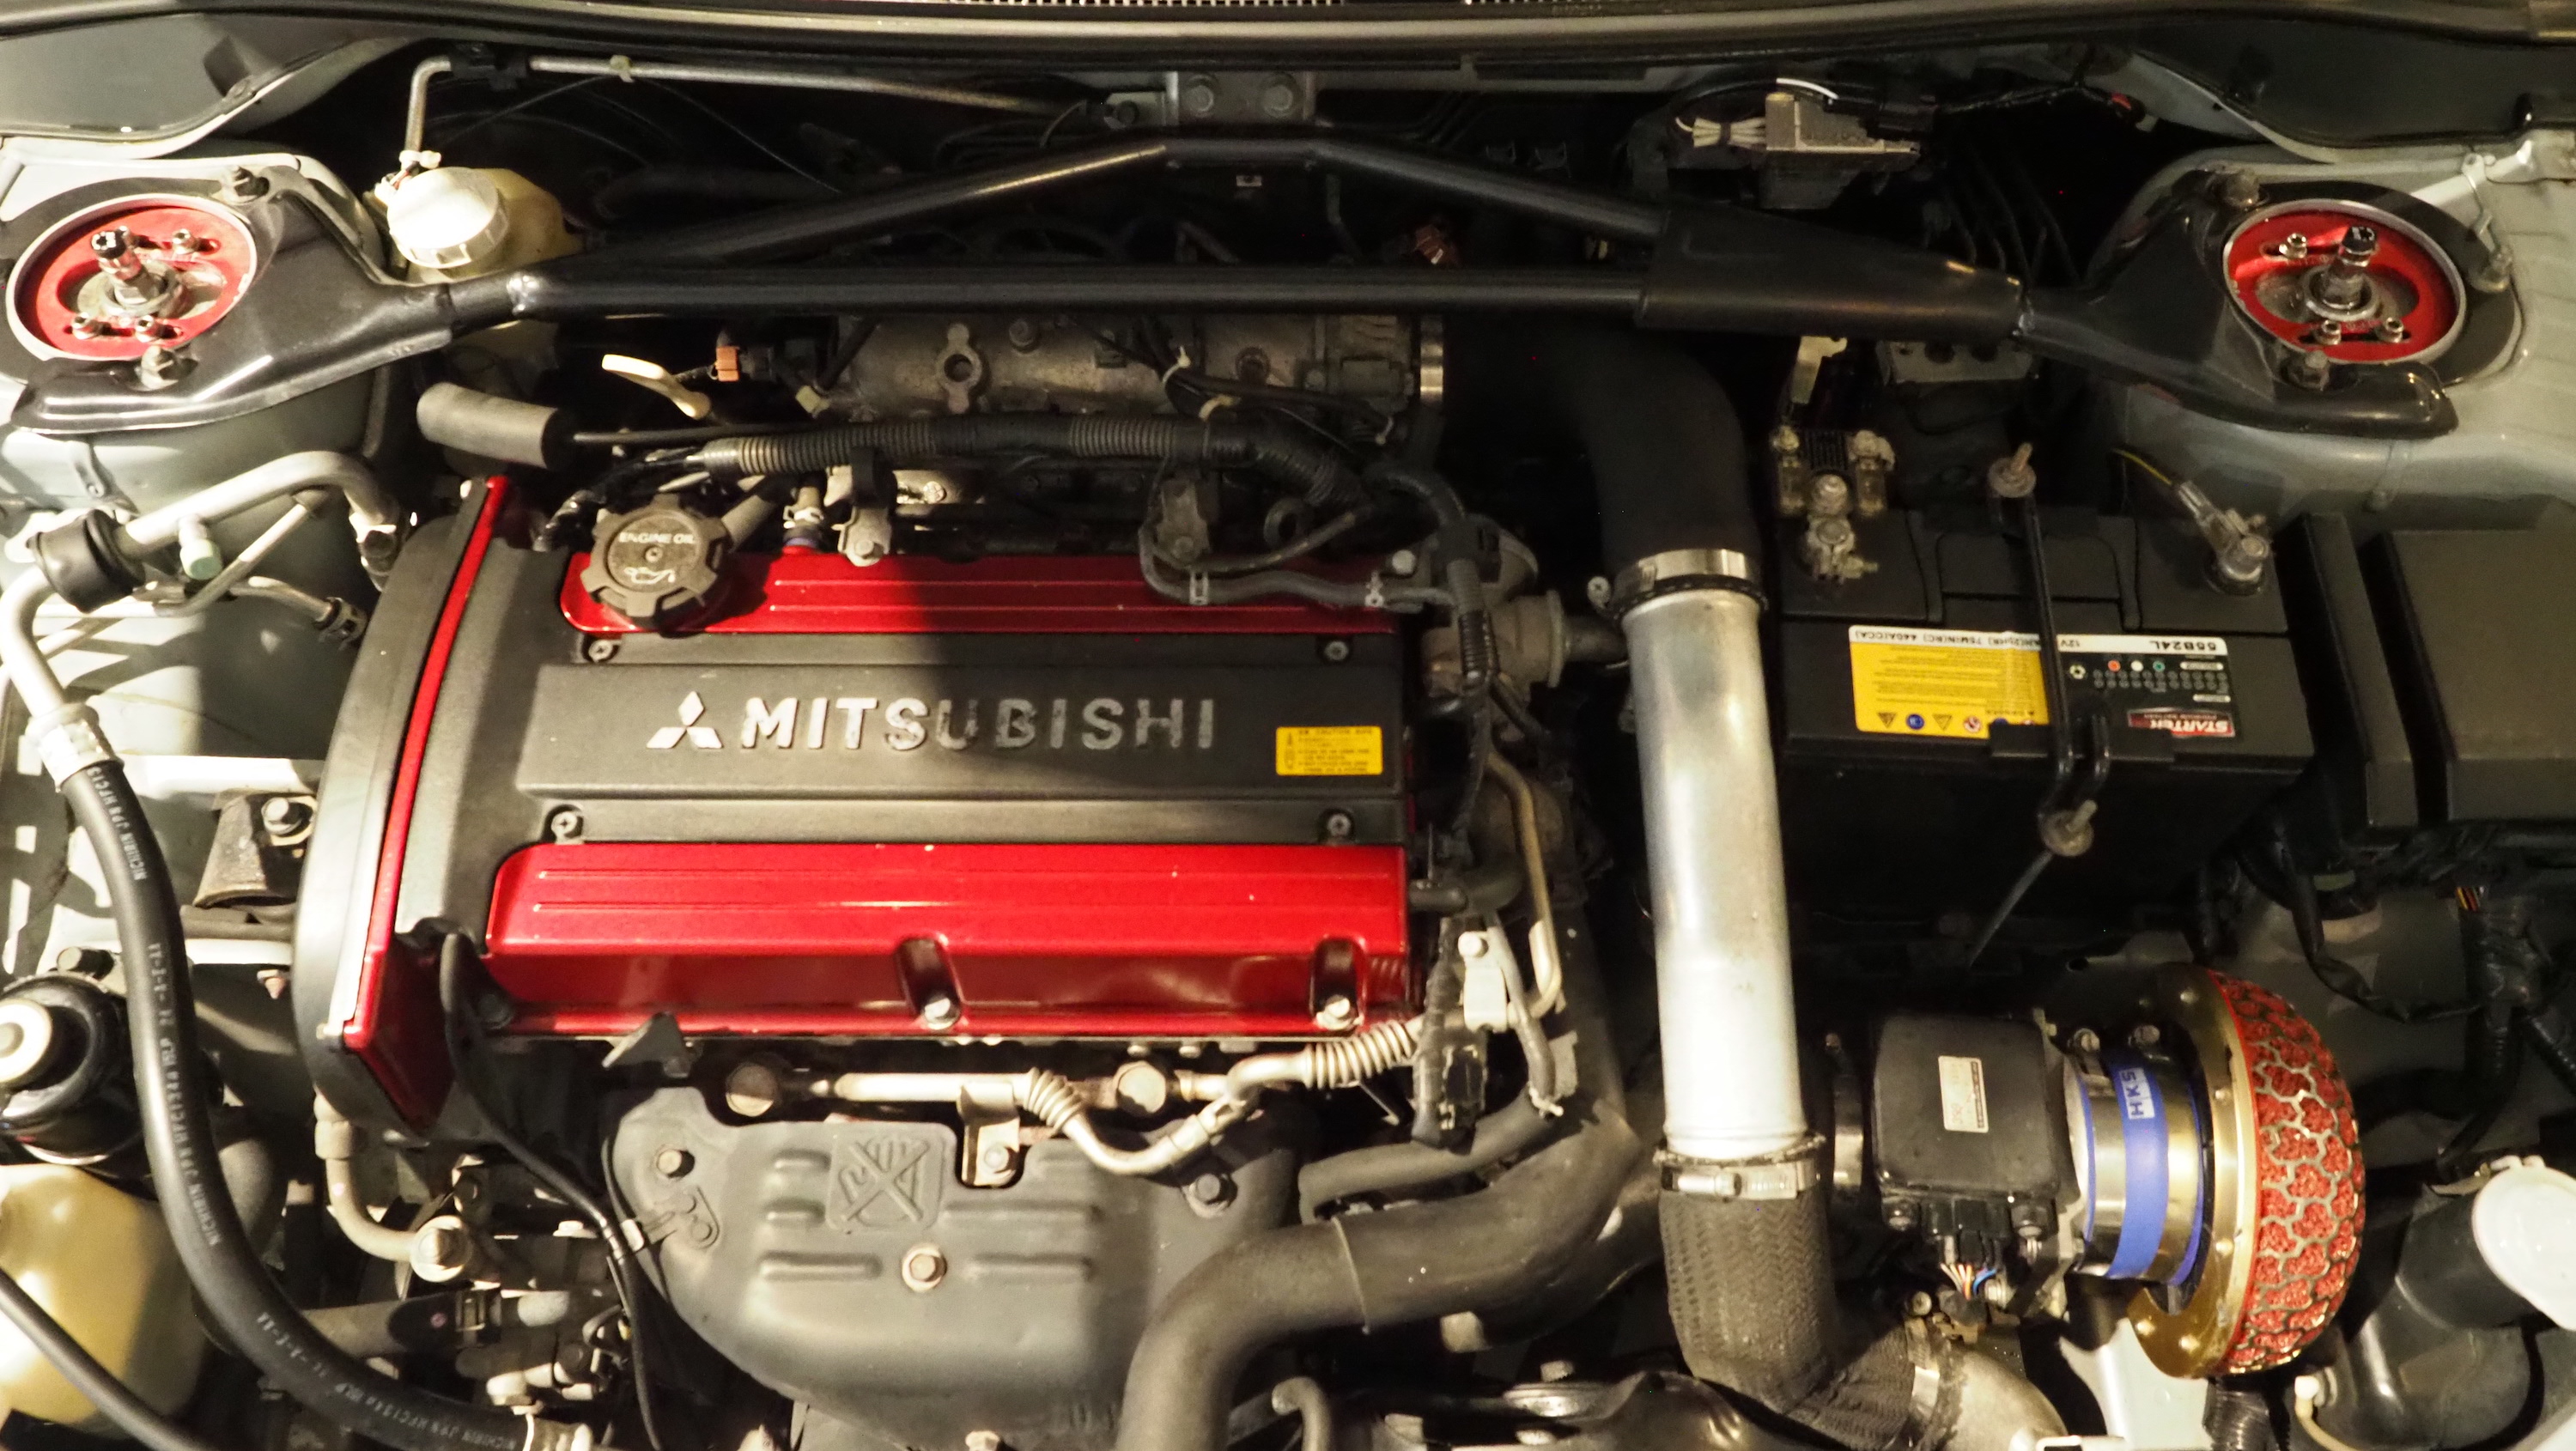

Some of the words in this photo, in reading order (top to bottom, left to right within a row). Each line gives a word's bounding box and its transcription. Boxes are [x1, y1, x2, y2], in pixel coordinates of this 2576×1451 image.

[618, 531, 672, 544] ENGINE
[672, 532, 696, 544] OIL
[2150, 641, 2216, 650] 55B24L
[741, 697, 1215, 750] MITSUBISHI
[2121, 1071, 2144, 1115] HKS
